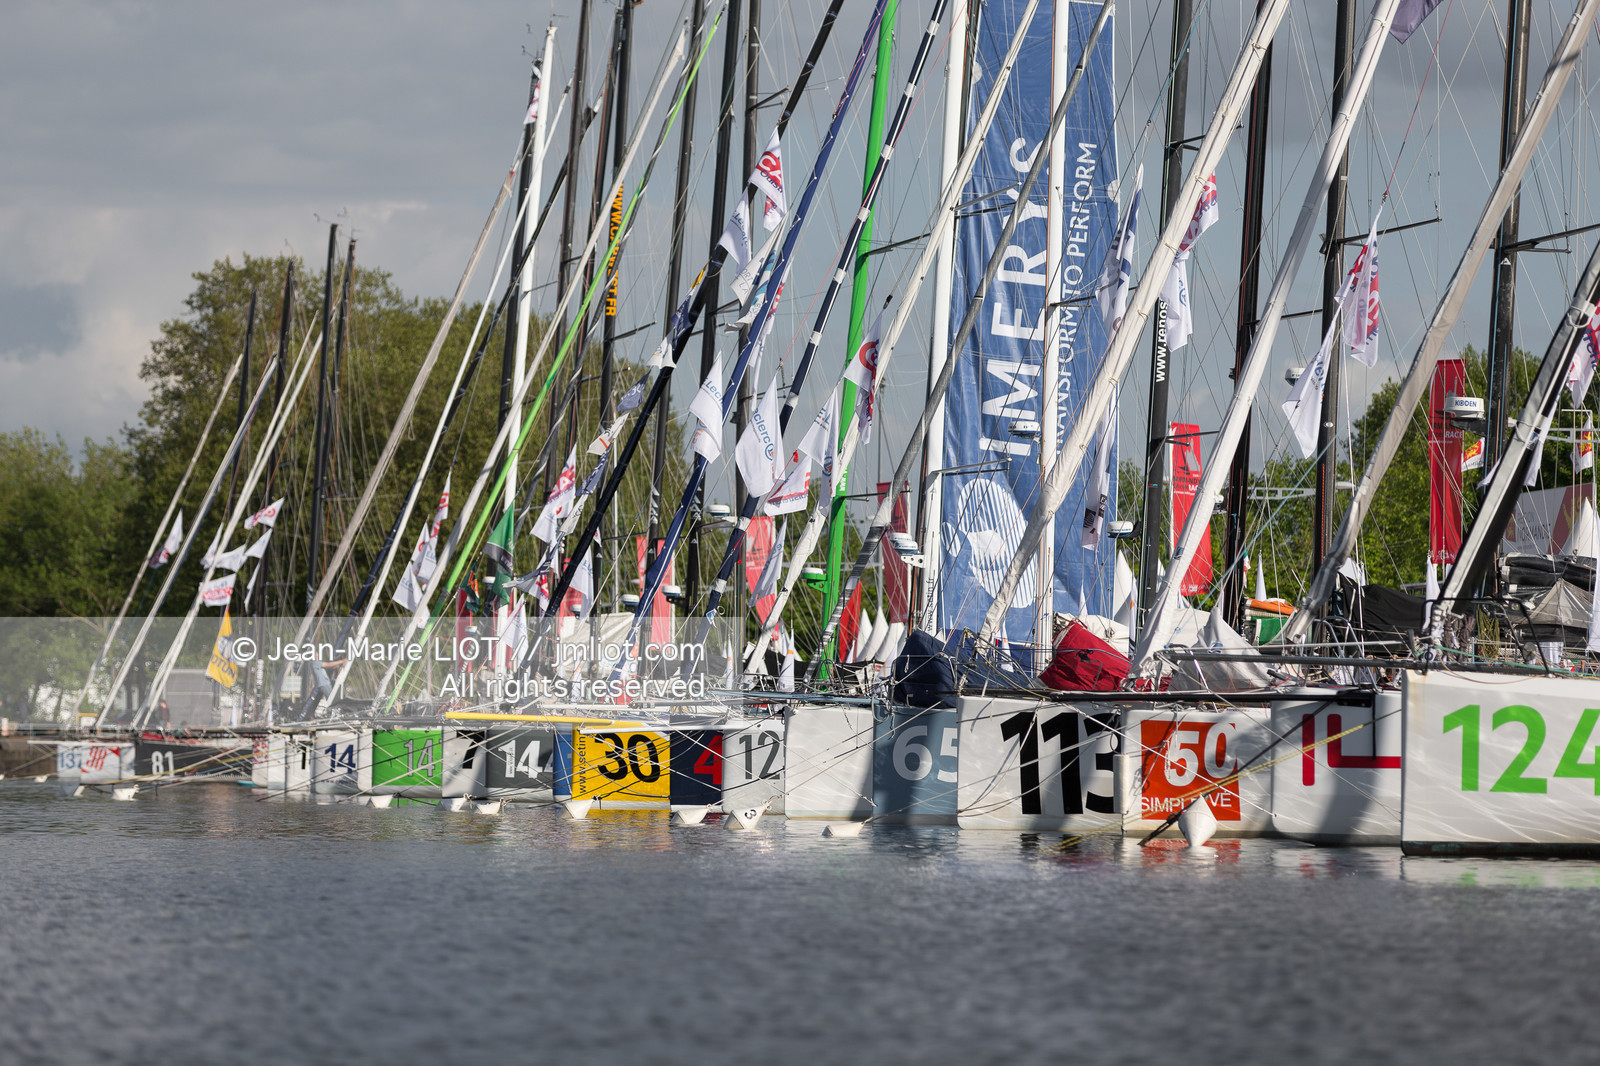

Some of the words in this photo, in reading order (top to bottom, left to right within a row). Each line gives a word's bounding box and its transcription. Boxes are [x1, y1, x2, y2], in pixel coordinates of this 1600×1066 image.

[1067, 142, 1098, 259] PERFORM
[1062, 264, 1083, 298] TO
[151, 751, 175, 776] 81
[325, 743, 356, 774] 14
[403, 739, 442, 777] 14
[594, 732, 661, 782] 30
[739, 730, 780, 780] 12
[1164, 722, 1239, 787] 50
[1442, 704, 1600, 797] 124
